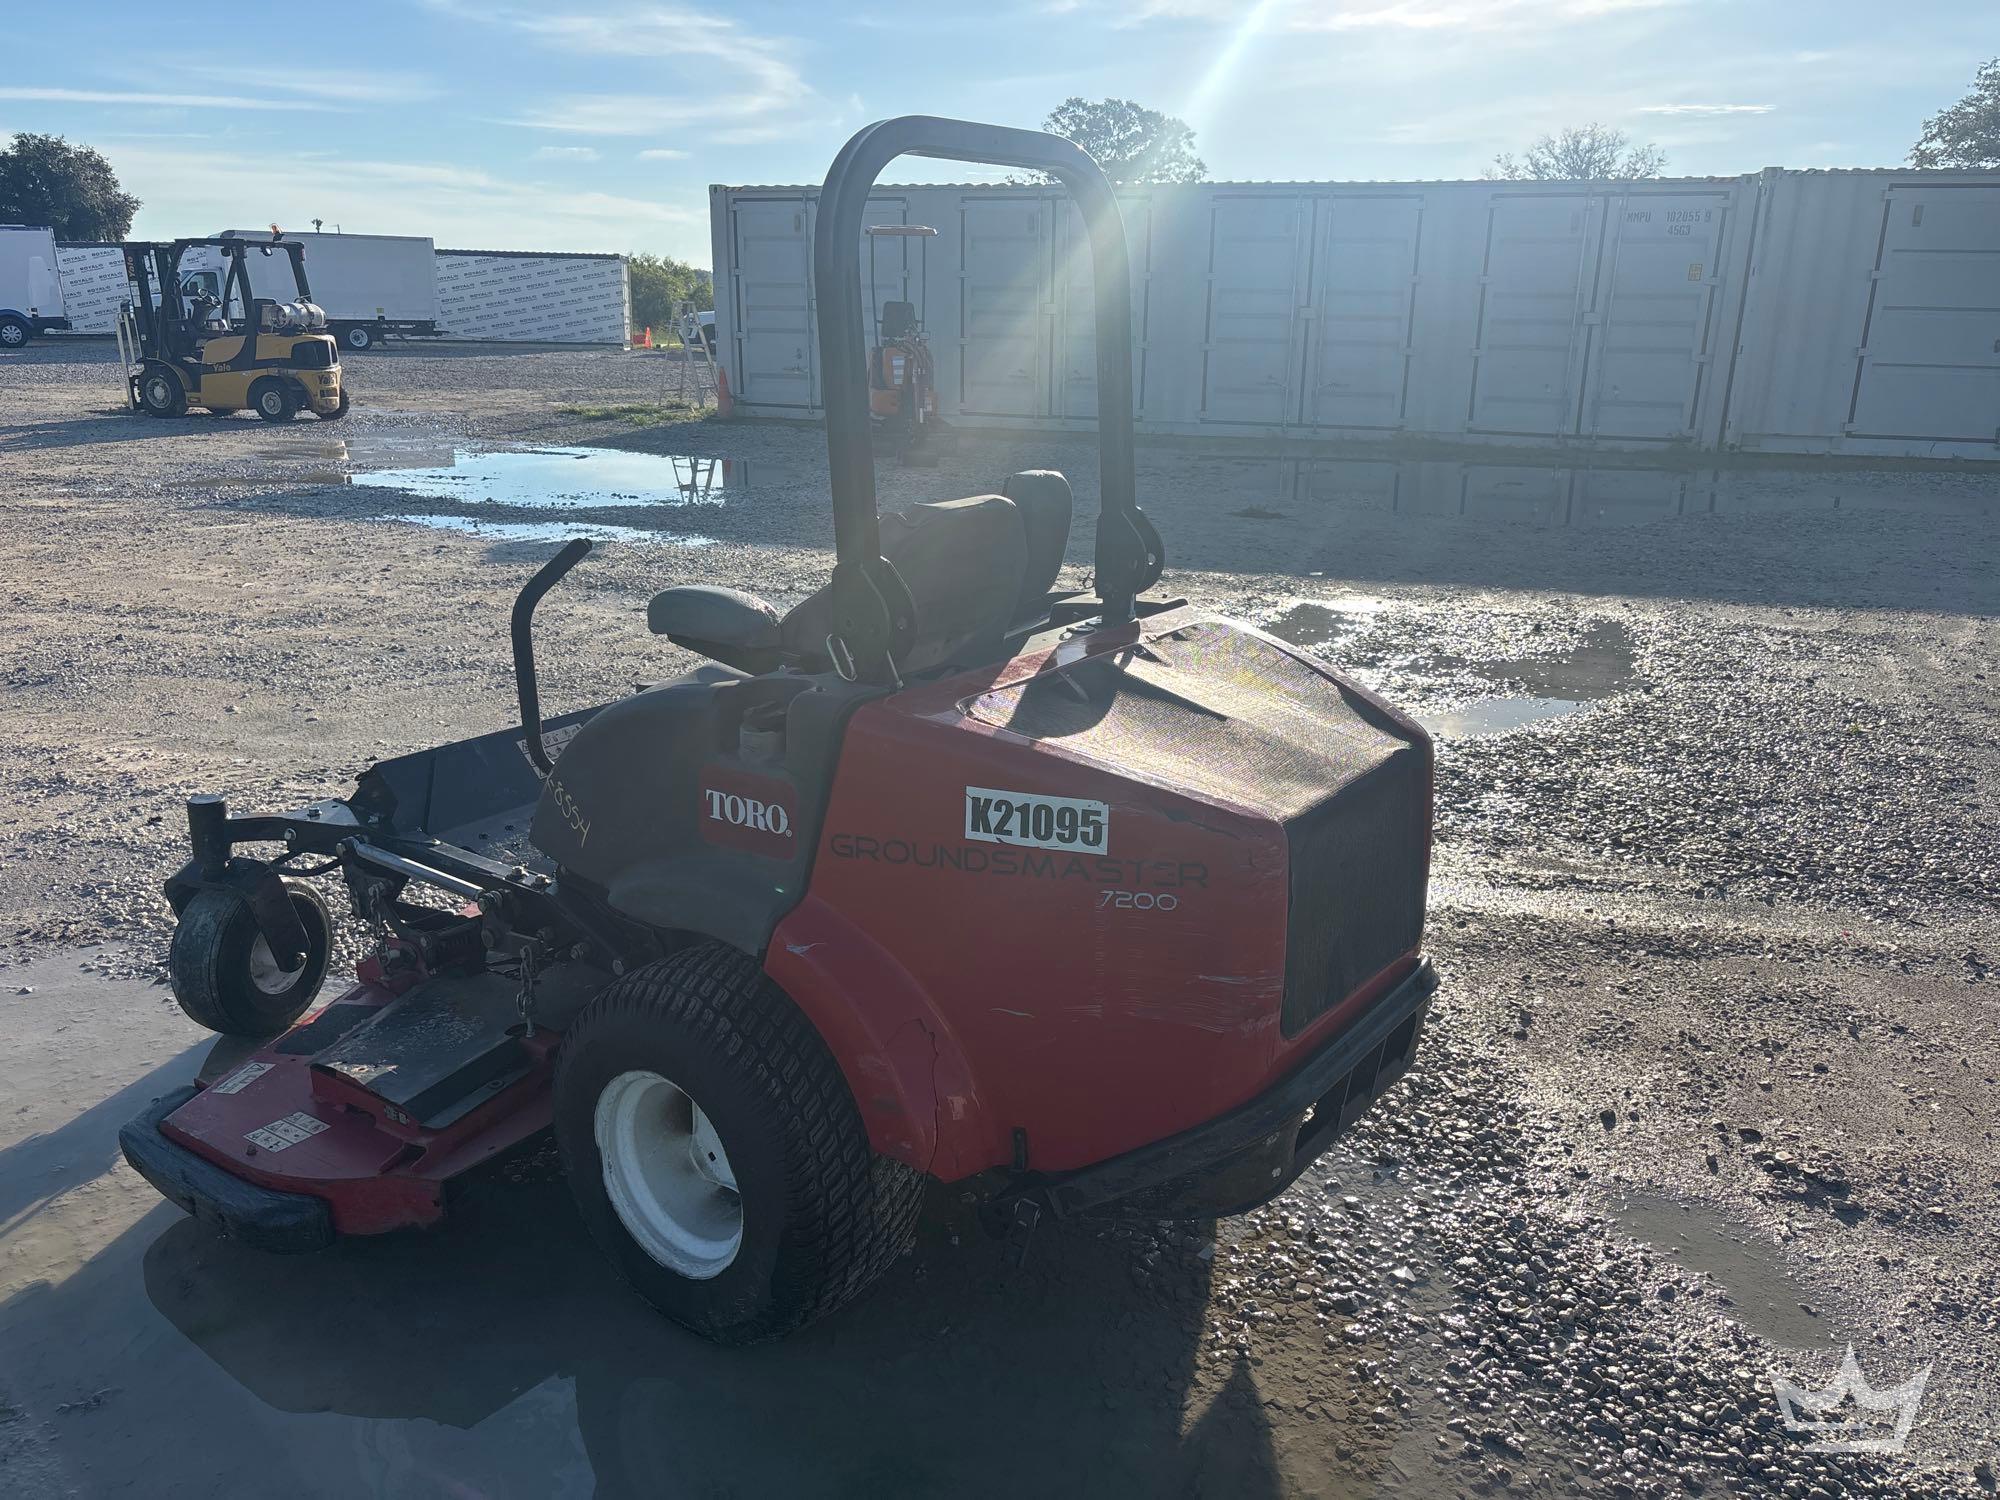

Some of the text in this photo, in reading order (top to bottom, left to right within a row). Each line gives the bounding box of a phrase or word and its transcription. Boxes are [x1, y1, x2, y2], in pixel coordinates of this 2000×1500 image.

[127, 256, 135, 277] Yale
[213, 363, 231, 372] Yale
[971, 796, 1103, 847] K21095
[831, 834, 1209, 889] GROUNDSMASTER
[1099, 889, 1178, 912] 7200
